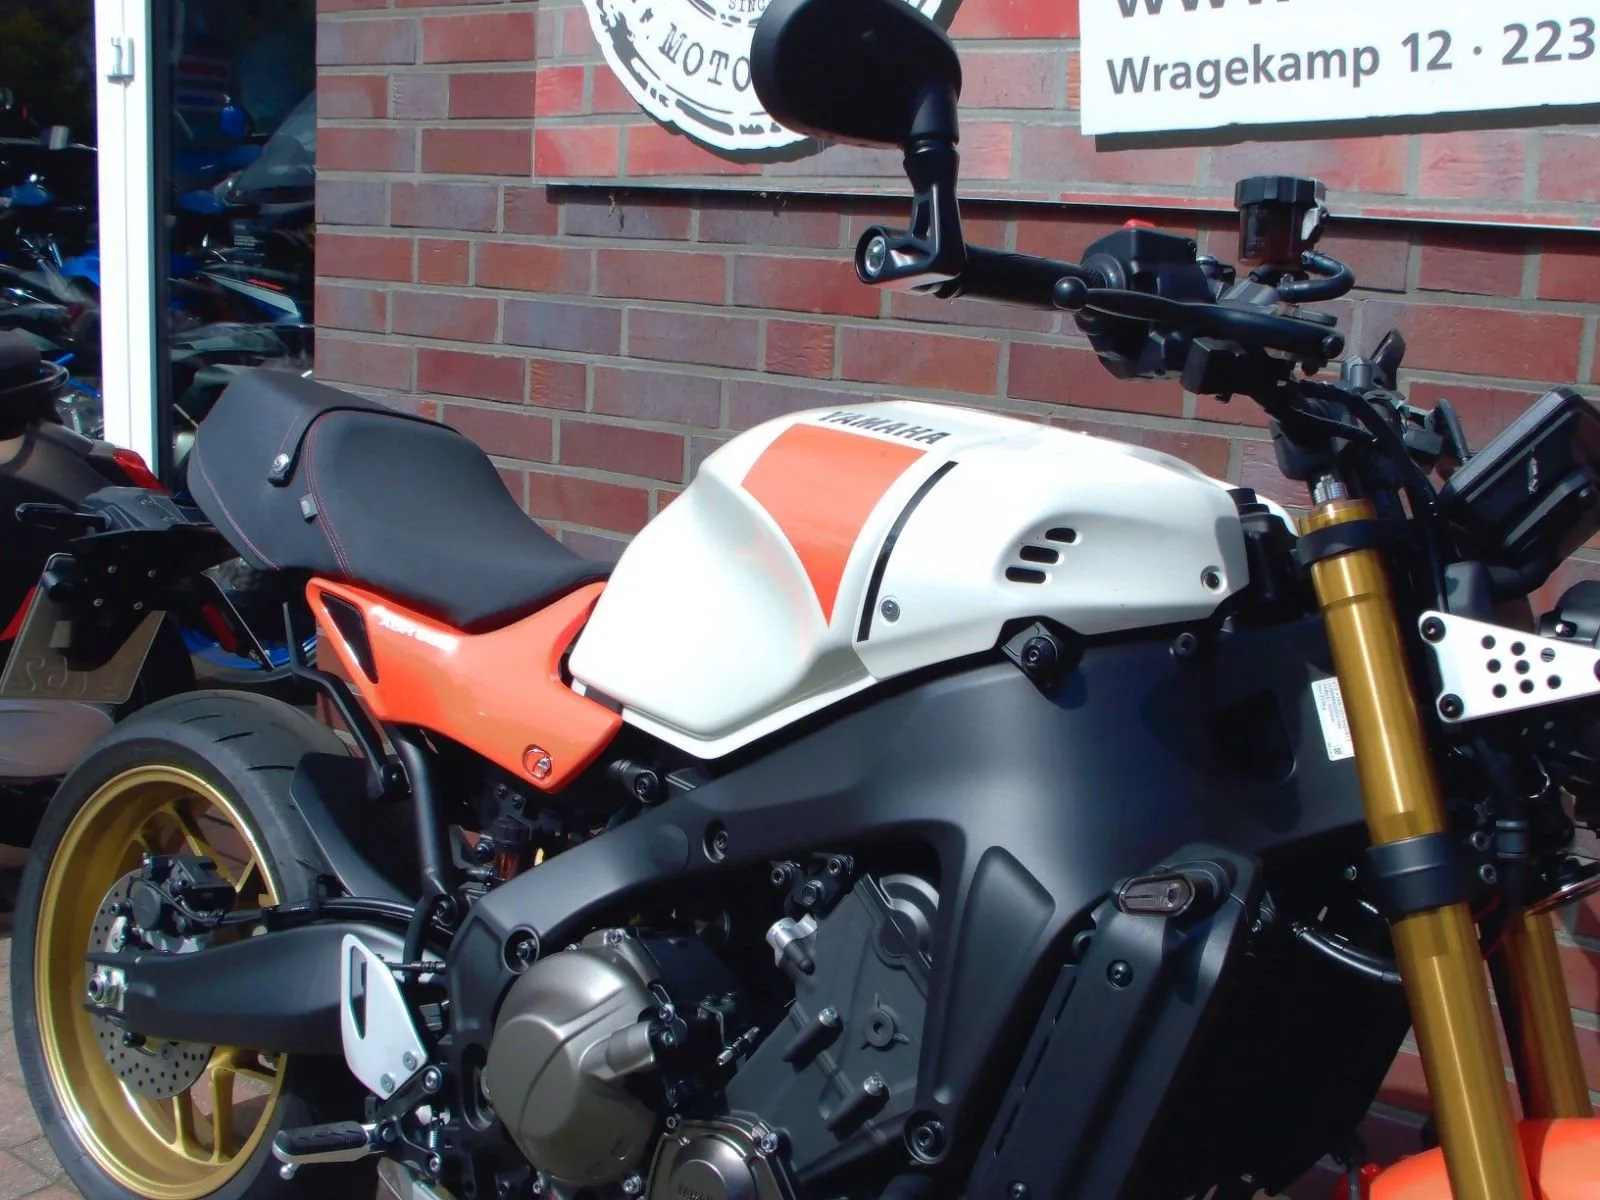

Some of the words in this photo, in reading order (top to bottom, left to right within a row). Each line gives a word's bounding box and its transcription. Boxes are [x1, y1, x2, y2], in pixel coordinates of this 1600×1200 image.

[1106, 43, 1380, 100] Wragekamp
[1400, 29, 1453, 73] 12
[1501, 17, 1596, 66] 223
[818, 410, 952, 445] YAMAHA
